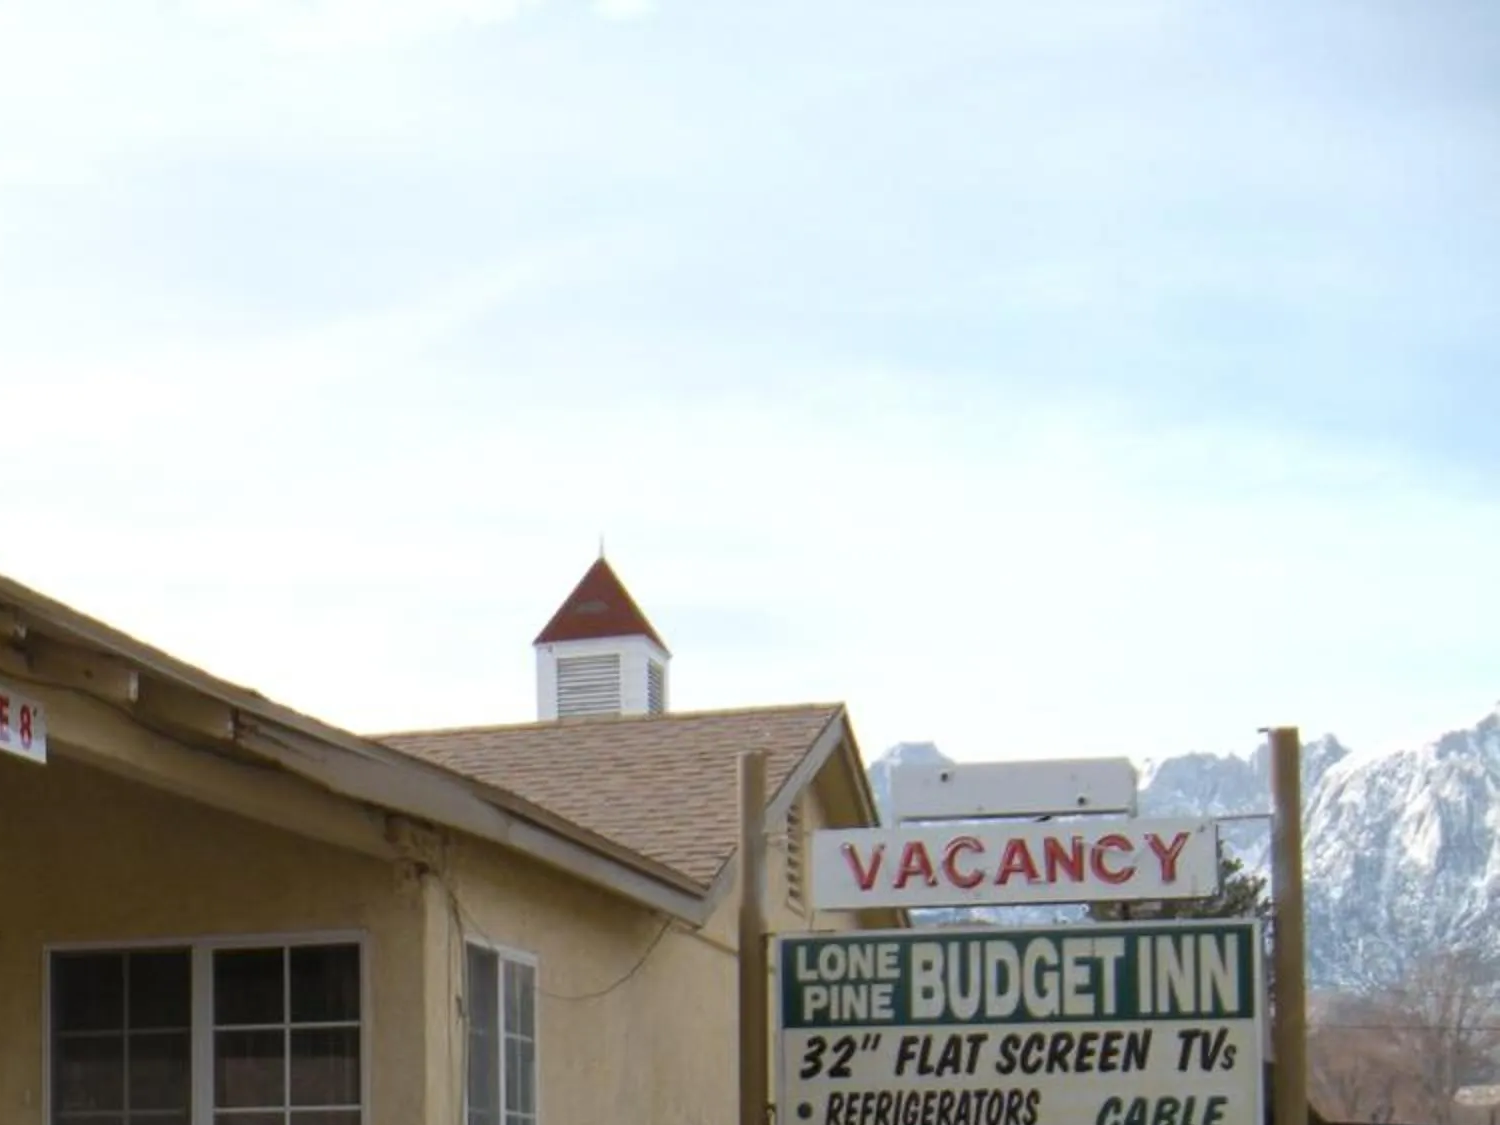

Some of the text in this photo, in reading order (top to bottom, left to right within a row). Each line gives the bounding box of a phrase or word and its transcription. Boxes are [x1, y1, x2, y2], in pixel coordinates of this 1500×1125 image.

[841, 832, 1191, 892] VACANCY
[797, 943, 900, 981] LONE
[911, 933, 1239, 1020] BUDGET INN
[803, 983, 895, 1021] PINE
[800, 1033, 881, 1080] 32"
[895, 1033, 989, 1077] FLAT
[995, 1028, 1153, 1075] SCREEN
